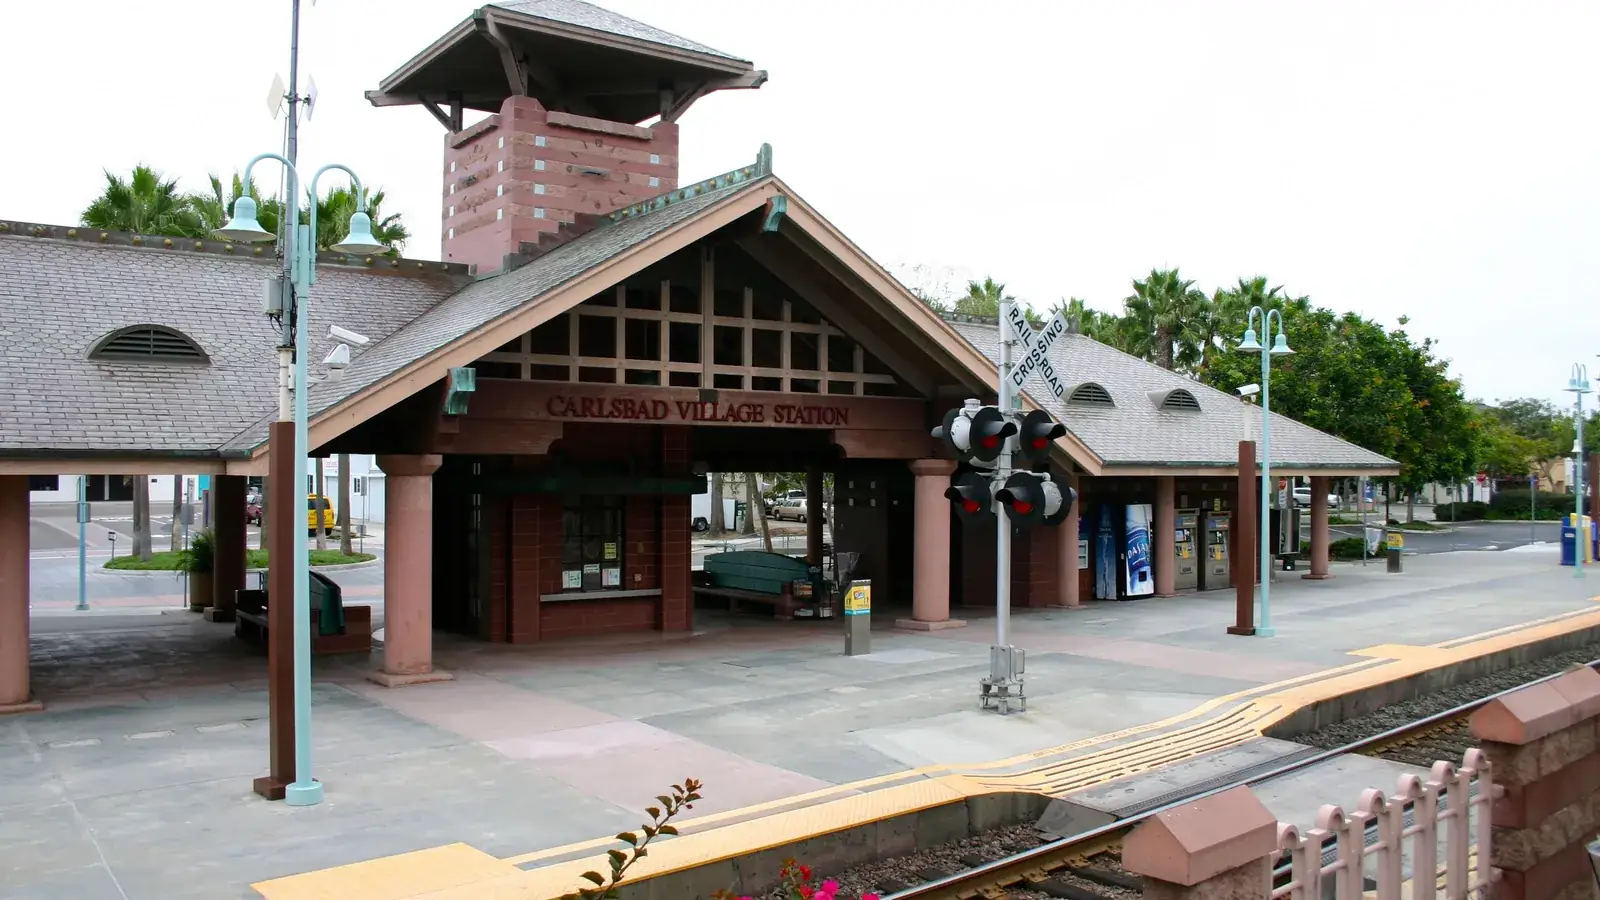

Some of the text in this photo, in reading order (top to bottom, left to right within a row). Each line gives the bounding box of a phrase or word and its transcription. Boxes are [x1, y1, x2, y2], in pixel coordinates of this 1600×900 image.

[1009, 307, 1064, 397] RAIL ROAD
[1012, 319, 1063, 386] CROSSING
[546, 394, 849, 425] CARLSBAD VILLAGE STATION
